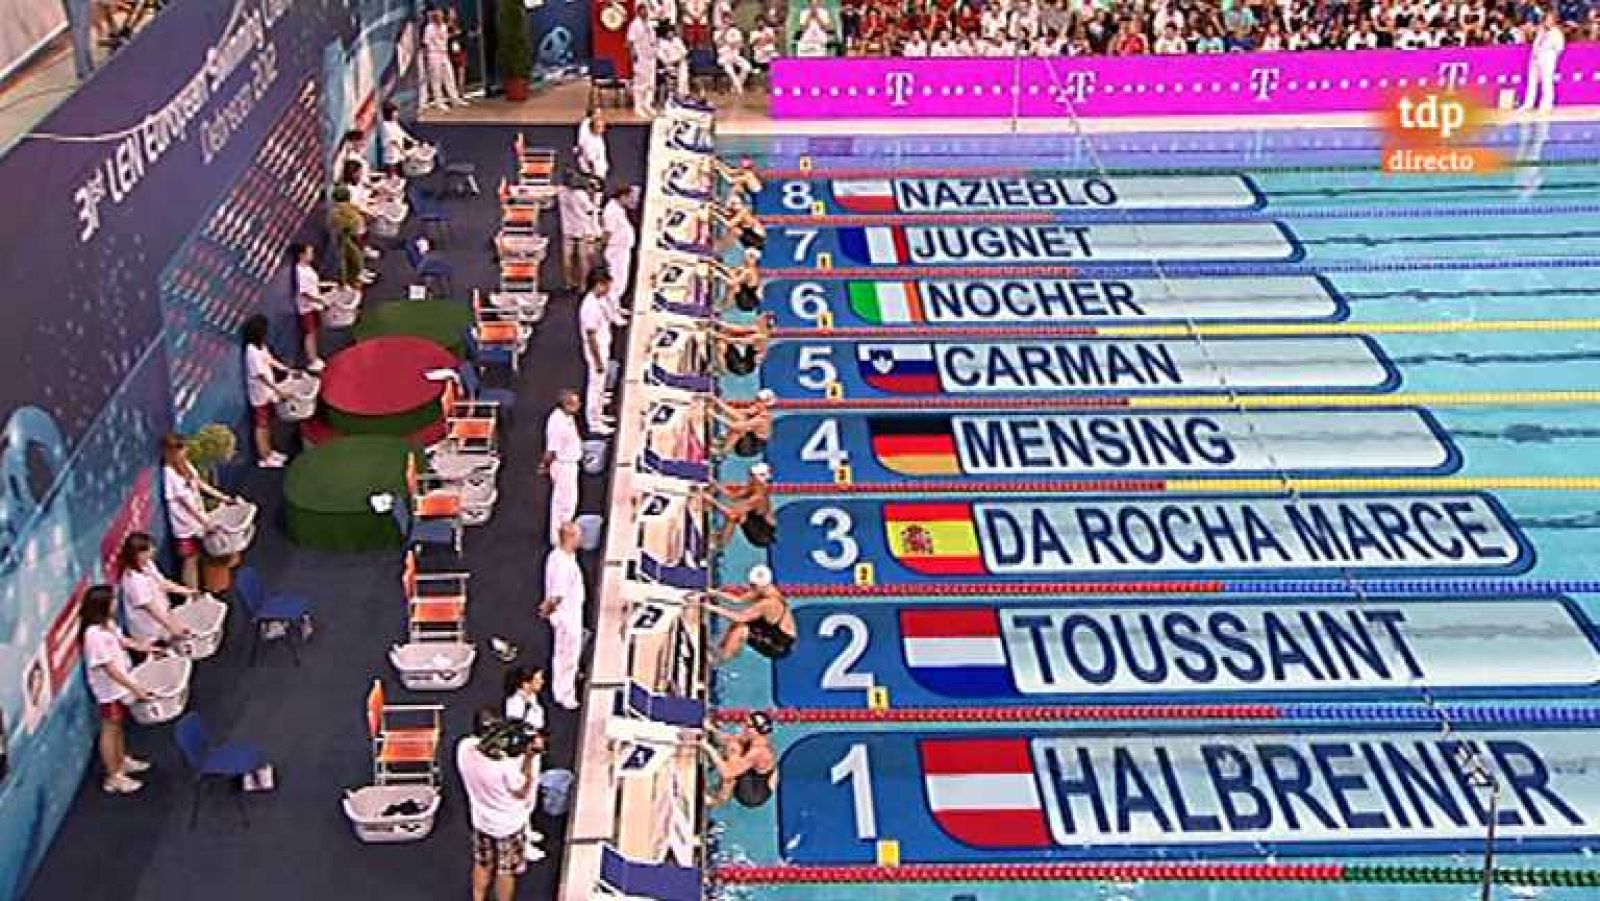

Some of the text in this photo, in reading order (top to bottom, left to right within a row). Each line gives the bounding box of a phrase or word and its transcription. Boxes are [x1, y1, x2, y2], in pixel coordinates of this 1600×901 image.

[885, 72, 914, 106] T
[1067, 71, 1097, 103] T
[1250, 68, 1281, 101] T
[1437, 62, 1469, 92] T
[105, 132, 146, 204] LEN
